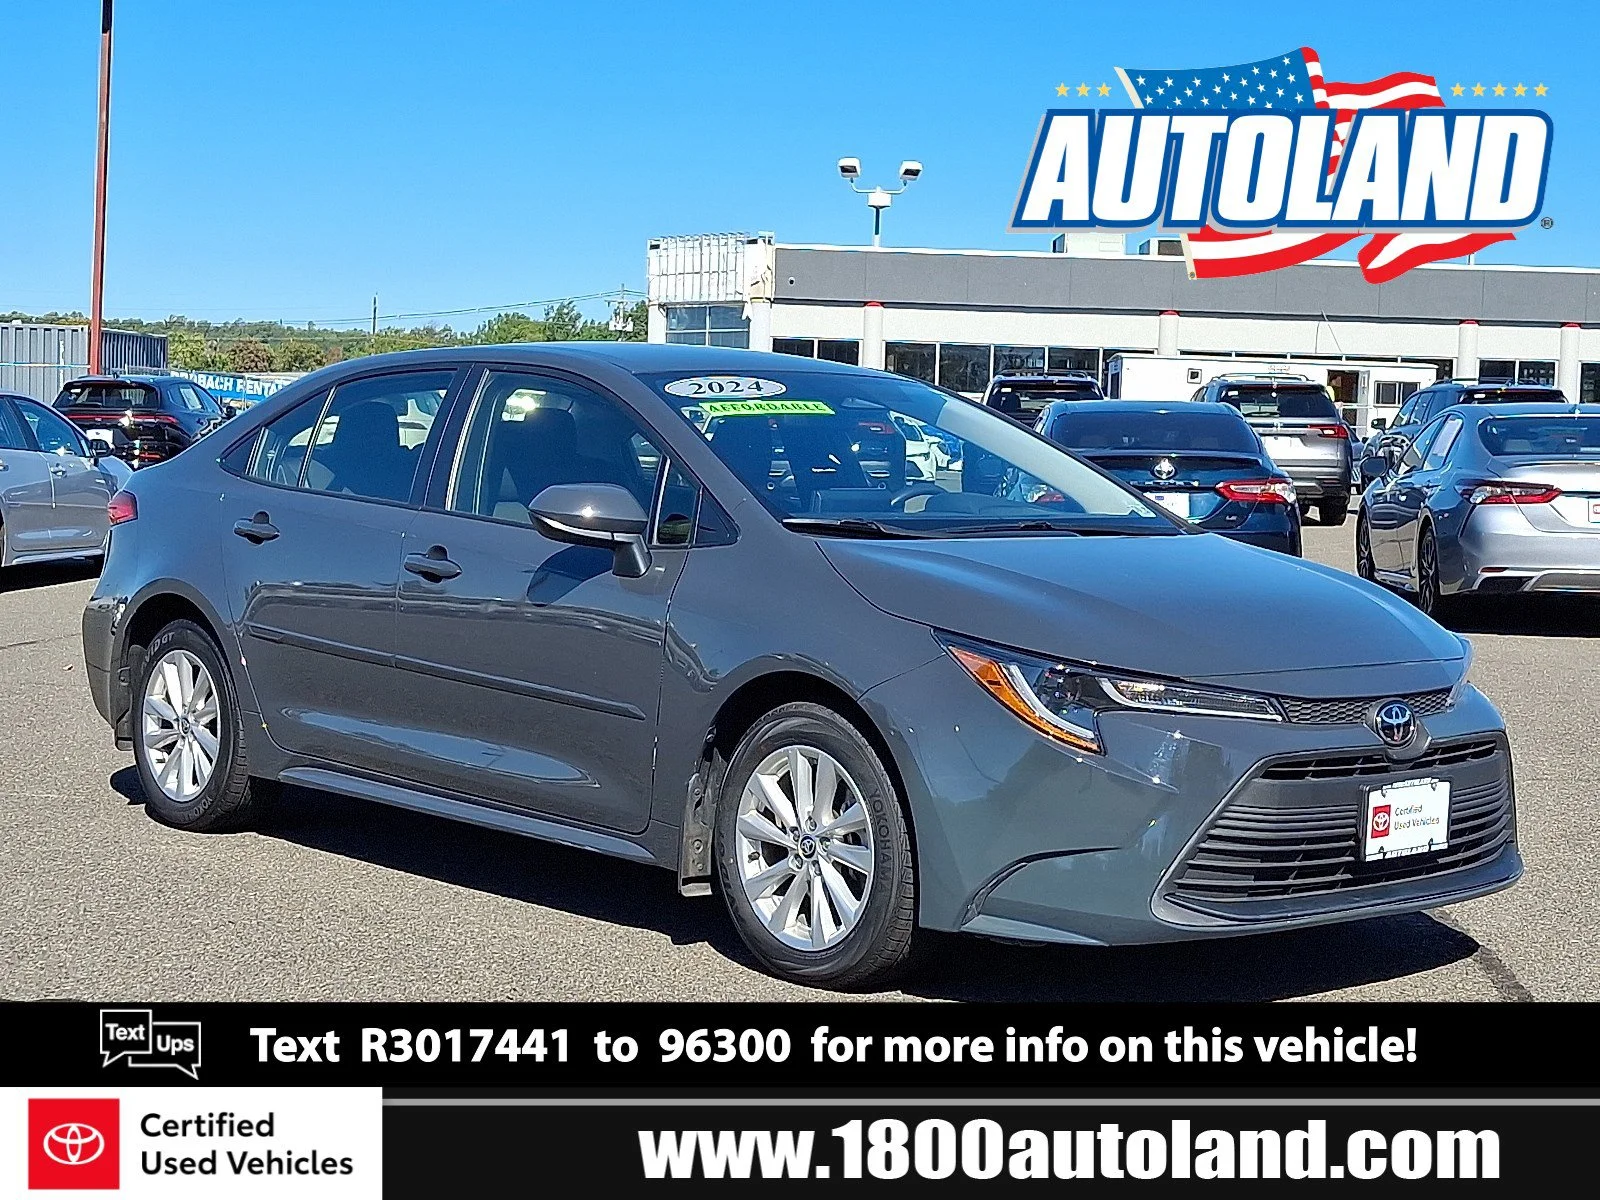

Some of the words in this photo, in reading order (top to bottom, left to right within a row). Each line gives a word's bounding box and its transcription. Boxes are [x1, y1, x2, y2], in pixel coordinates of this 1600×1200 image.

[688, 379, 764, 395] 2024
[708, 401, 829, 414] AFFORDABLE
[1394, 820, 1411, 831] Used
[1412, 816, 1440, 828] Vehicles
